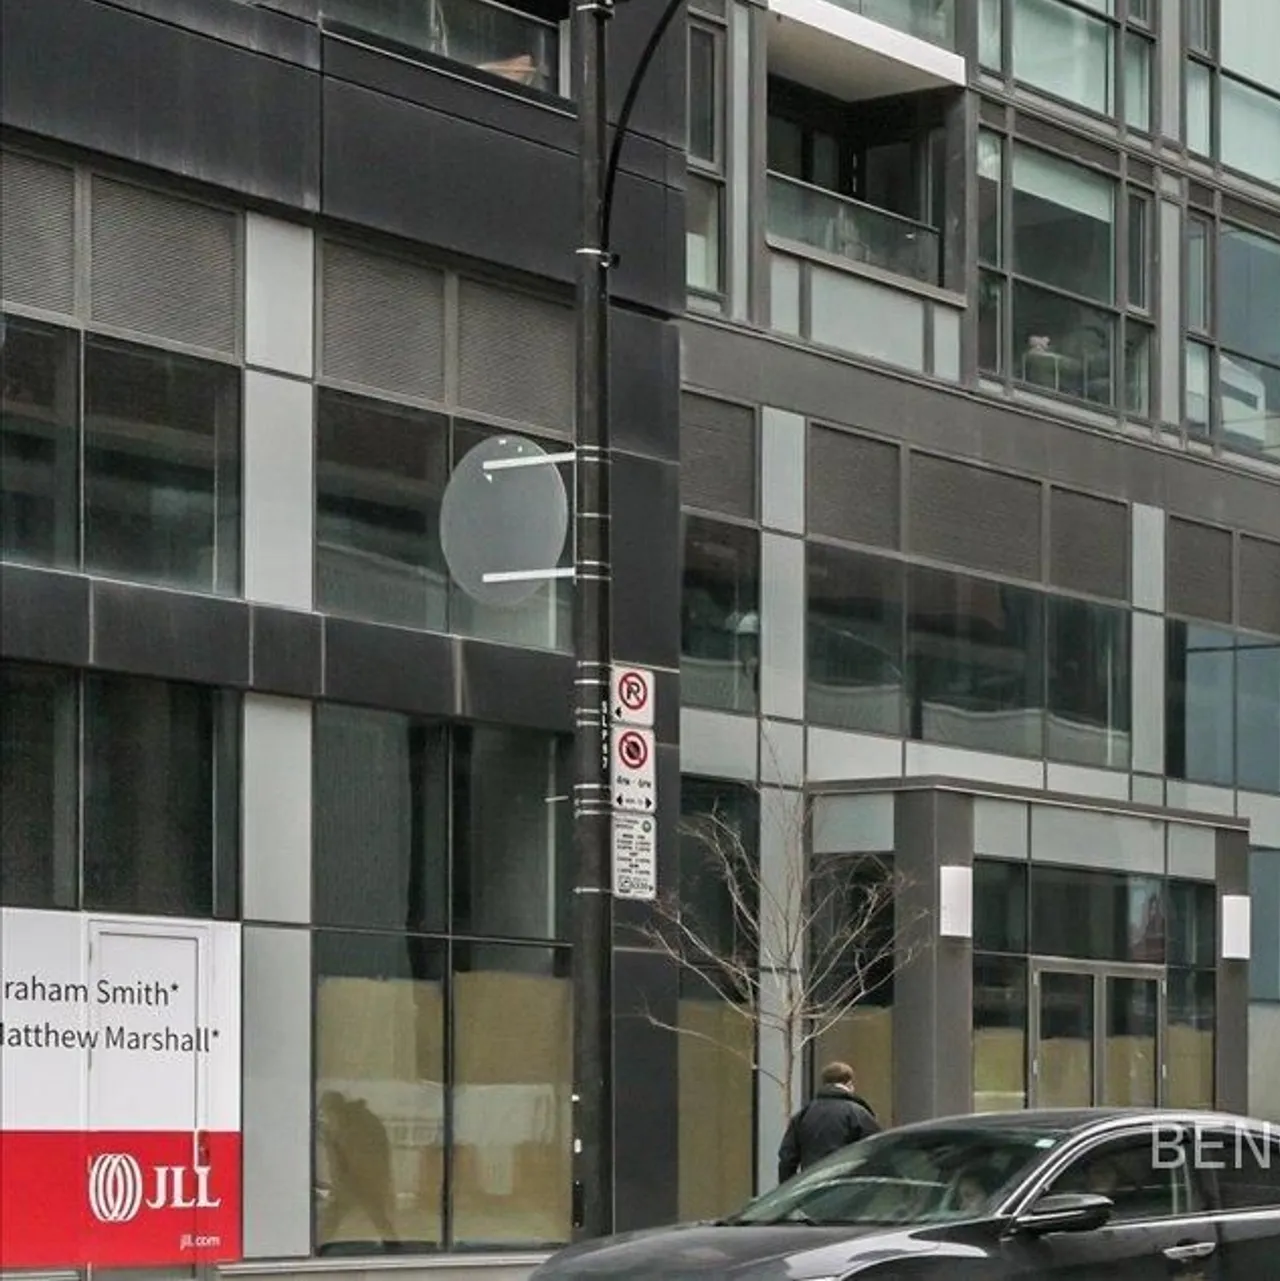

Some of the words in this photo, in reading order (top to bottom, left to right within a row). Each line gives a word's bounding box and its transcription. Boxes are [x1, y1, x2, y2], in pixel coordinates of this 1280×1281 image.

[5, 976, 88, 1003] raham
[146, 1166, 222, 1209] JLL
[179, 1233, 221, 1251] jll.com
